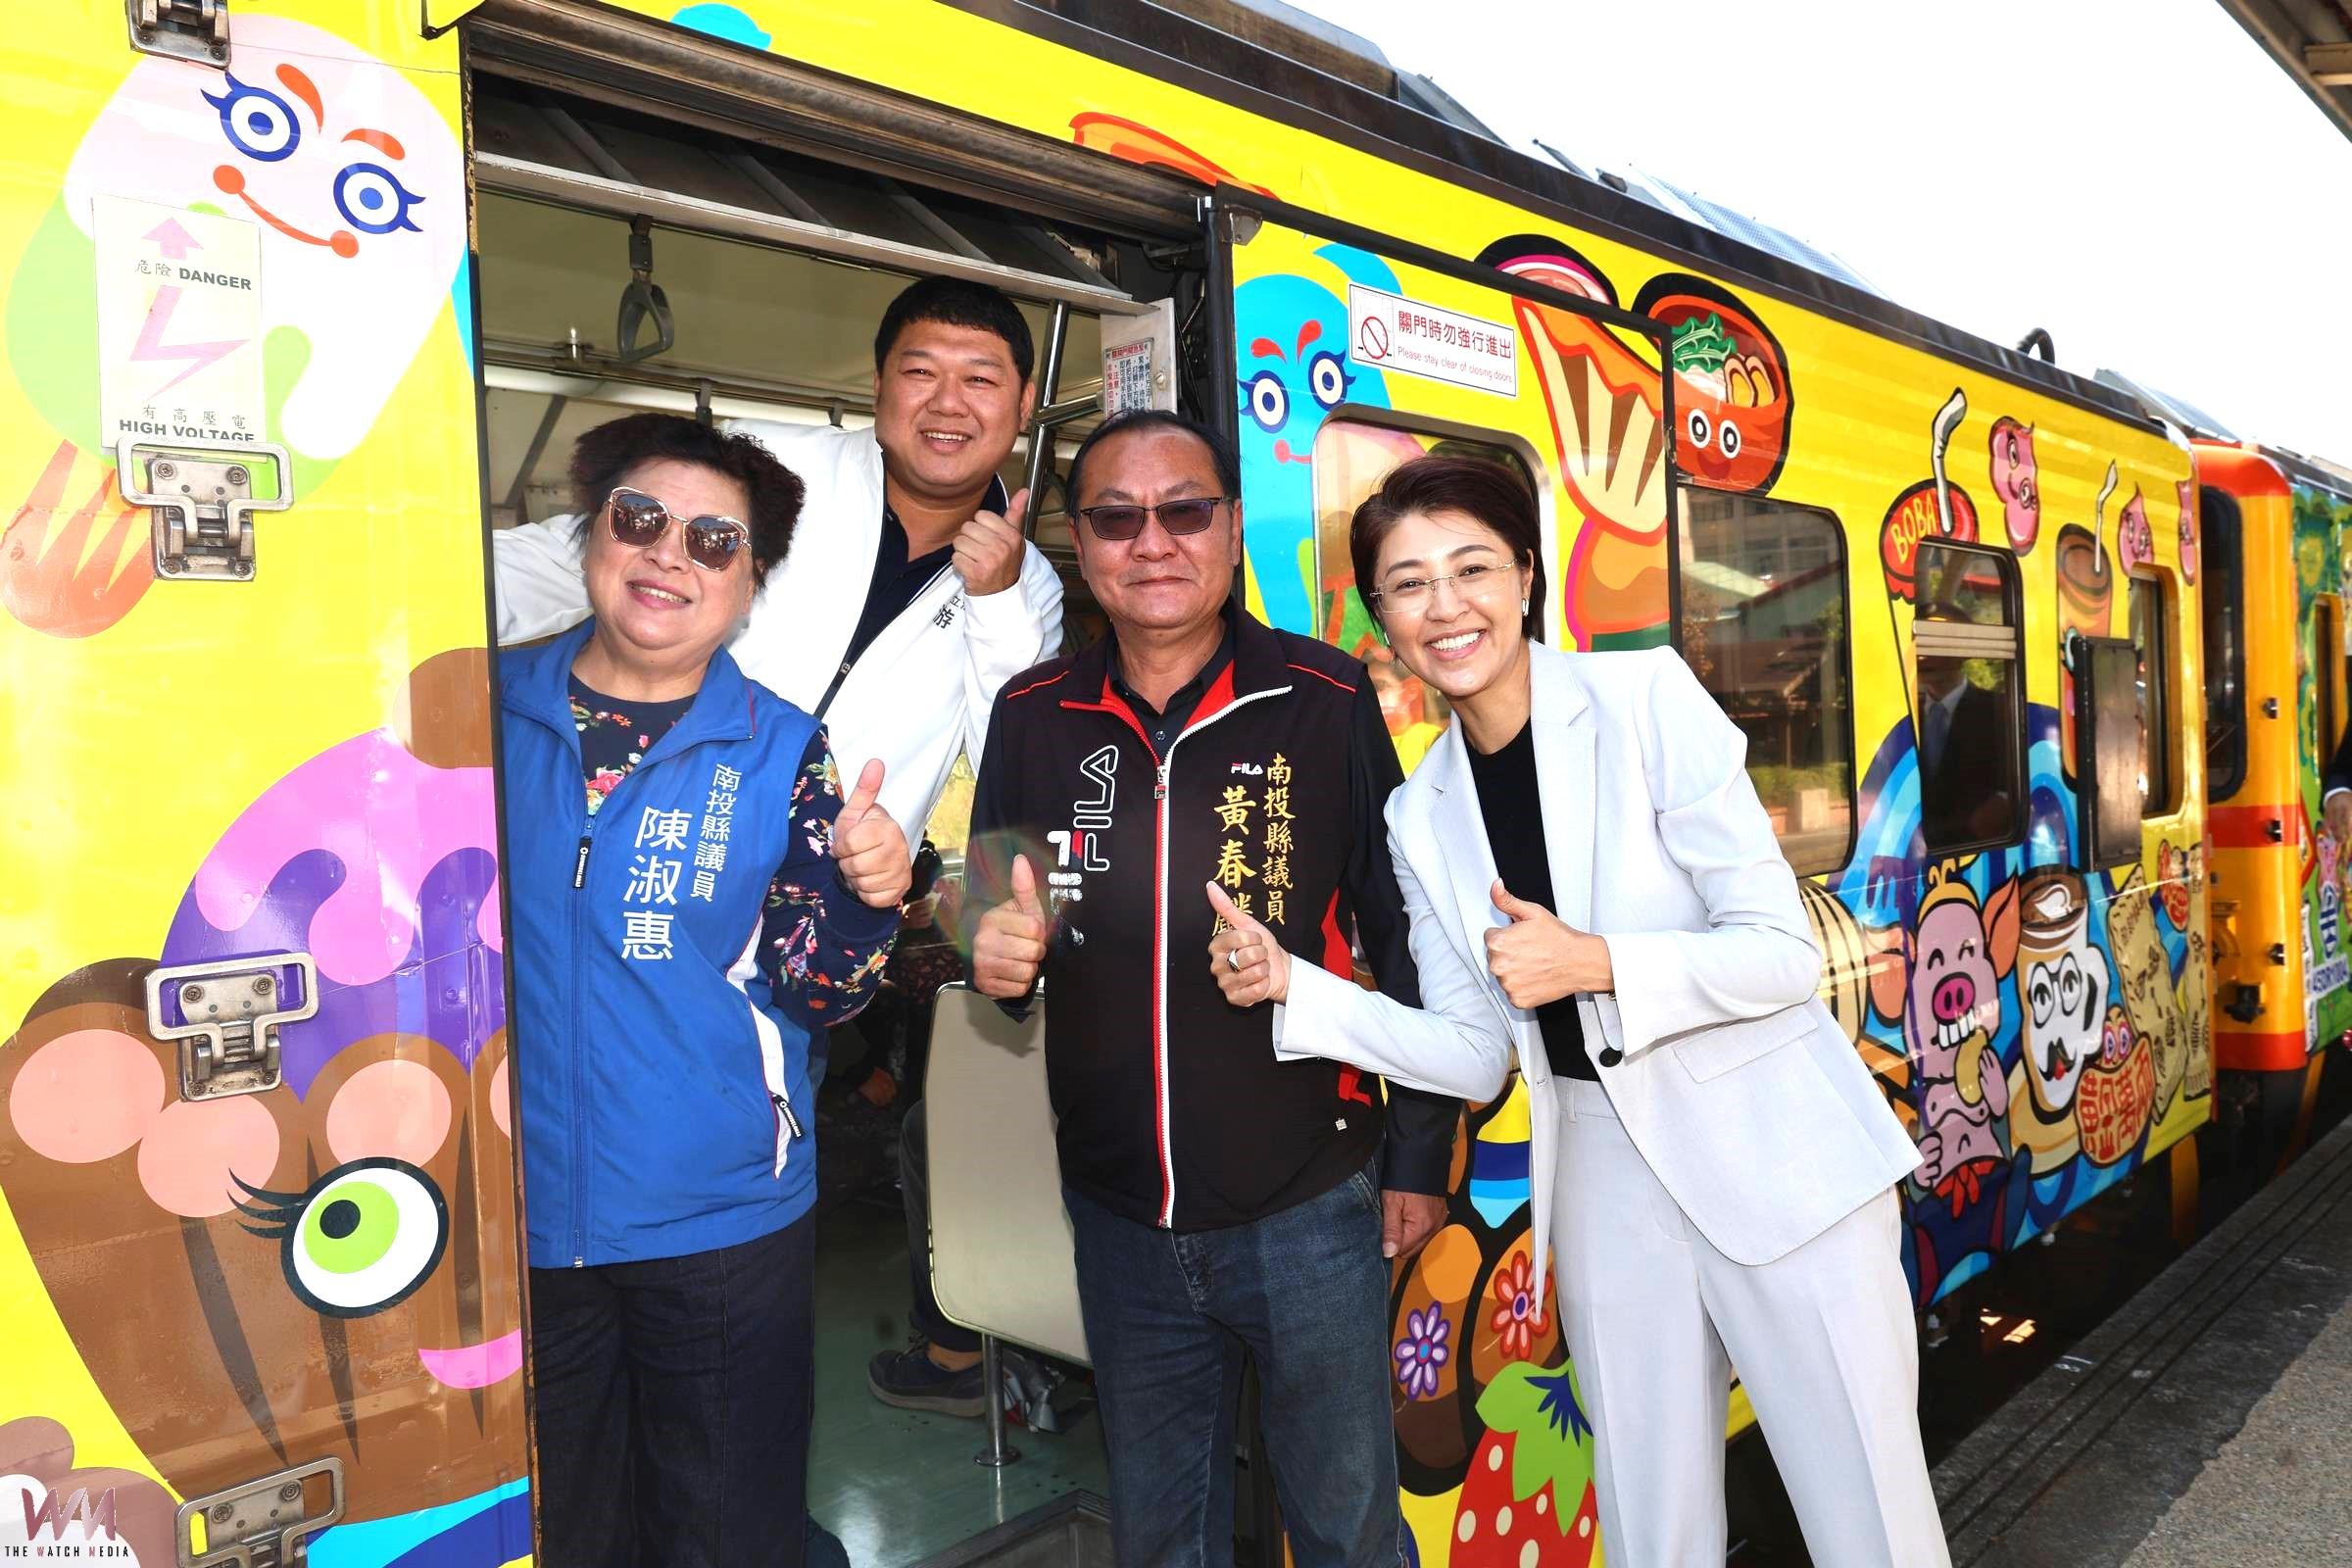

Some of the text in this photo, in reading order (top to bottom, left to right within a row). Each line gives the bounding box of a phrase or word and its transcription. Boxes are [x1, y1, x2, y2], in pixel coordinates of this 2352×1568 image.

[135, 259, 171, 277] 危險
[179, 268, 251, 290] DANGER
[1397, 310, 1512, 360] 關門時勿強行進出
[1398, 347, 1512, 383] Please stay clear of closing doors
[120, 419, 254, 441] HIGH VOLTAGE
[144, 405, 245, 429] 有高壓電
[1890, 491, 1937, 564] BOBA
[1231, 762, 1263, 776] FILA
[689, 763, 743, 903] 南投縣議員
[1261, 752, 1297, 925] 南投縣議員
[620, 806, 693, 960] 陳淑惠
